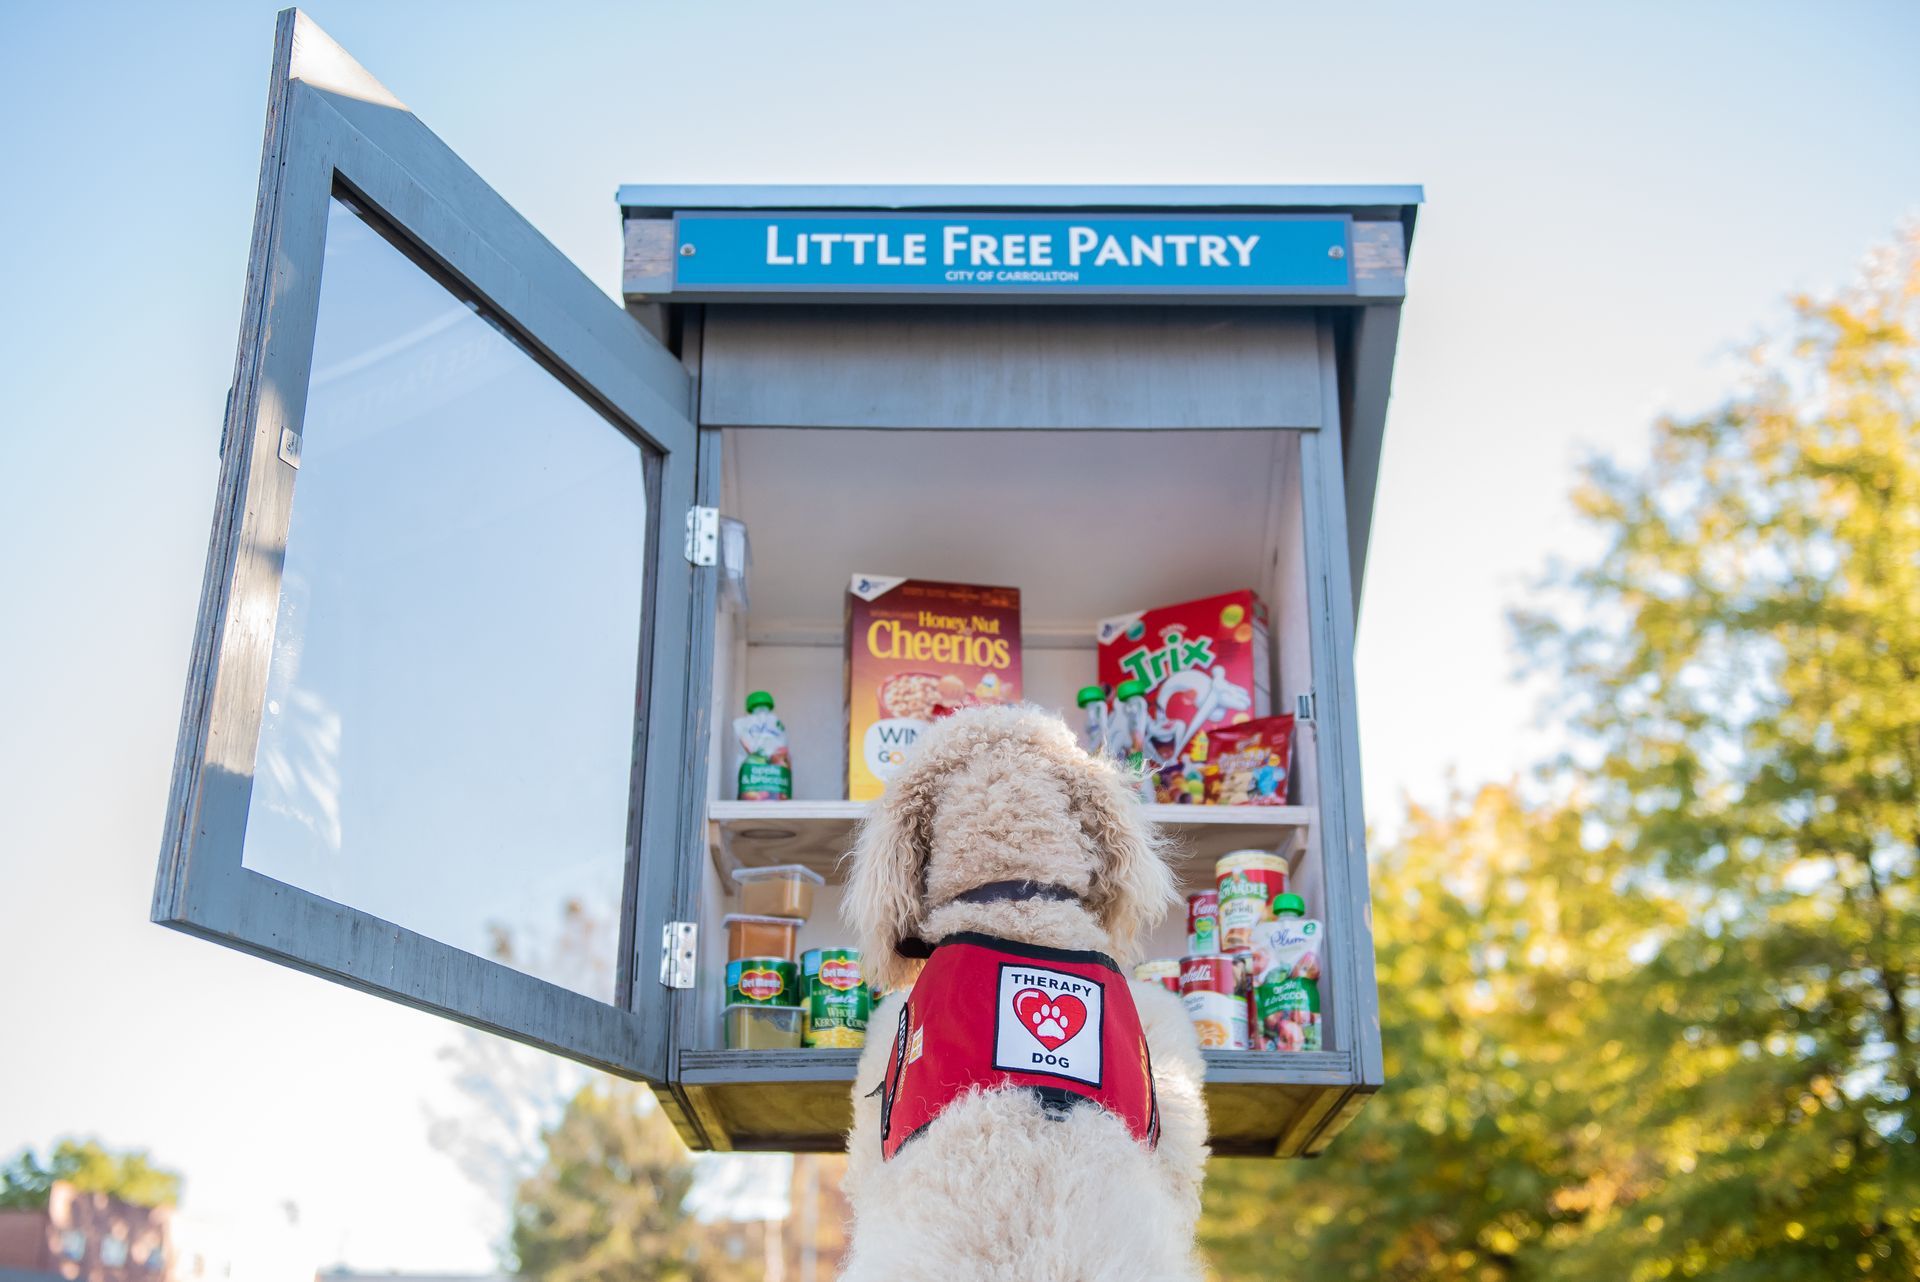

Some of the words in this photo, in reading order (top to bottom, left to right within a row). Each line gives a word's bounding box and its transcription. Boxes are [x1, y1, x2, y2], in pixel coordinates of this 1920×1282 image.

[766, 225, 926, 265] LITTLE
[943, 226, 1053, 266] FREE
[1068, 226, 1260, 267] PANTRY
[945, 271, 975, 281] CITY
[976, 271, 995, 281] OF
[996, 271, 1079, 281] CARROLLTON
[918, 610, 968, 633] Honey
[970, 615, 999, 634] Nut
[867, 619, 1011, 669] Cheerios
[1120, 631, 1213, 690] Trix
[1011, 973, 1092, 997] THERAPY
[1032, 1052, 1070, 1069] DOG
